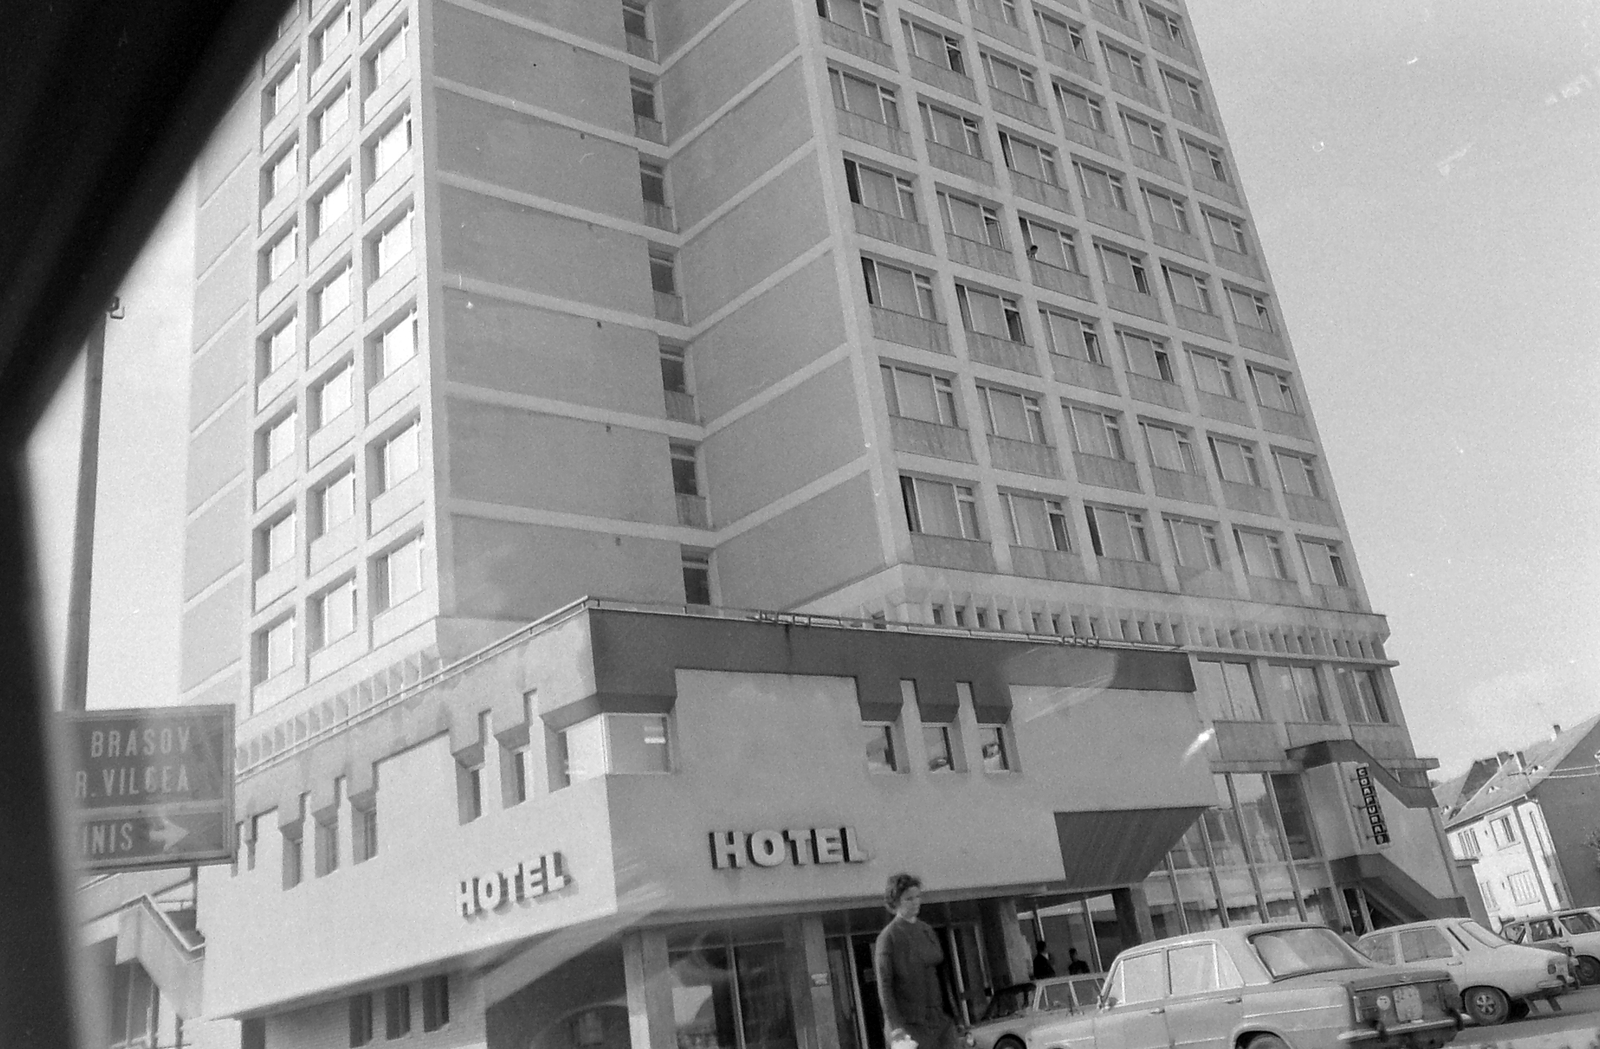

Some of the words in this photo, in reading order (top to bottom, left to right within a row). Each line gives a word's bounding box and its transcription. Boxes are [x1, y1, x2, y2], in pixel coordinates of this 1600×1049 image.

[91, 726, 190, 758] BRASOV
[709, 827, 867, 869] HOTEL
[456, 852, 575, 920] HOTEL
